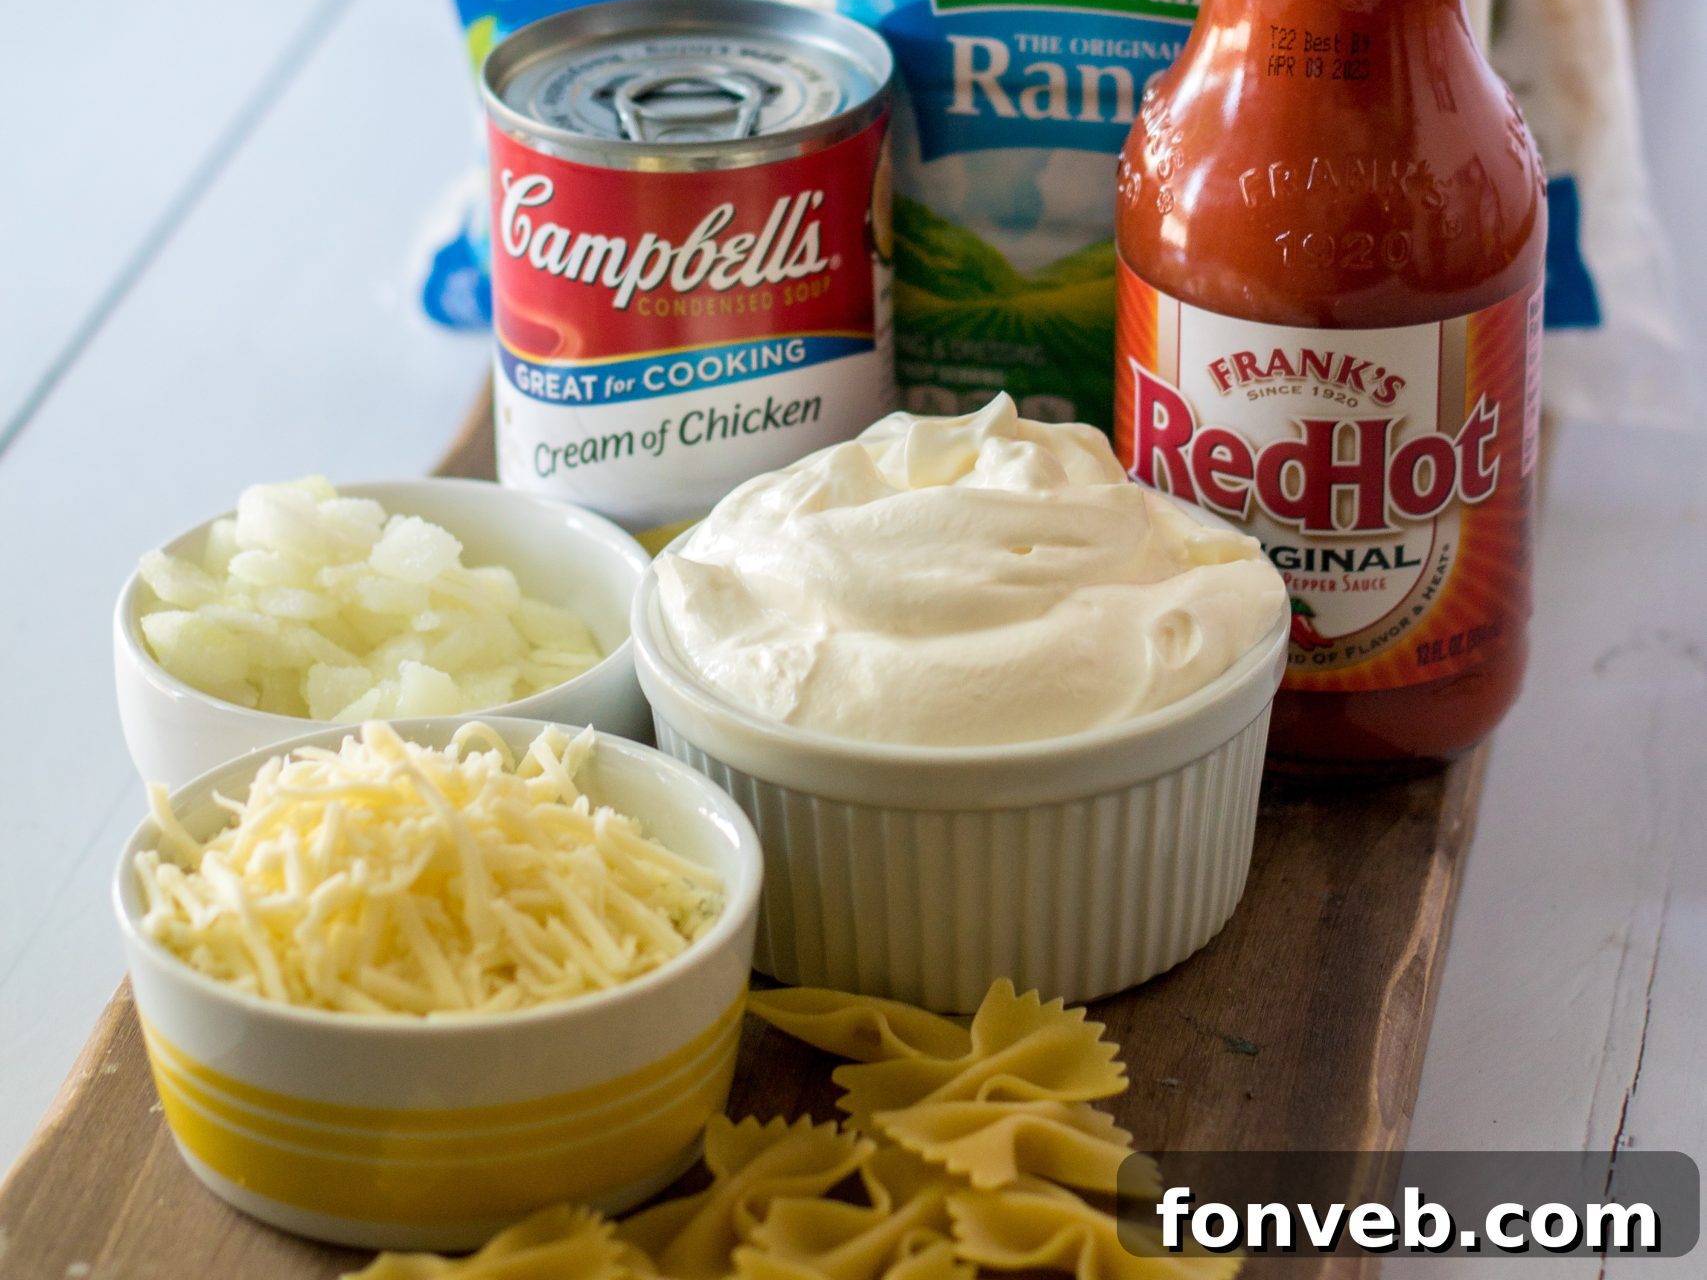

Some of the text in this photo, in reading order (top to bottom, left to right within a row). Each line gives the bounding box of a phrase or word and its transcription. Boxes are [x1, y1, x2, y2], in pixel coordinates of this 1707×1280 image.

[1014, 33, 1063, 55] THE
[1304, 30, 1341, 54] Best
[946, 33, 1163, 125] Ran
[1267, 54, 1296, 77] APR
[500, 167, 830, 312] Campbell's
[1274, 229, 1412, 271] 1920
[638, 276, 833, 319] CONDENSED SOUP
[515, 337, 807, 403] GREAT for COOKING
[1207, 347, 1408, 407] FRANK'S
[1246, 384, 1360, 409] SINCE 1920
[534, 394, 823, 479] Cream of Chicken
[1261, 543, 1422, 573] GINAL
[1312, 650, 1338, 666] OF
[1345, 617, 1412, 660] FLAVOR
